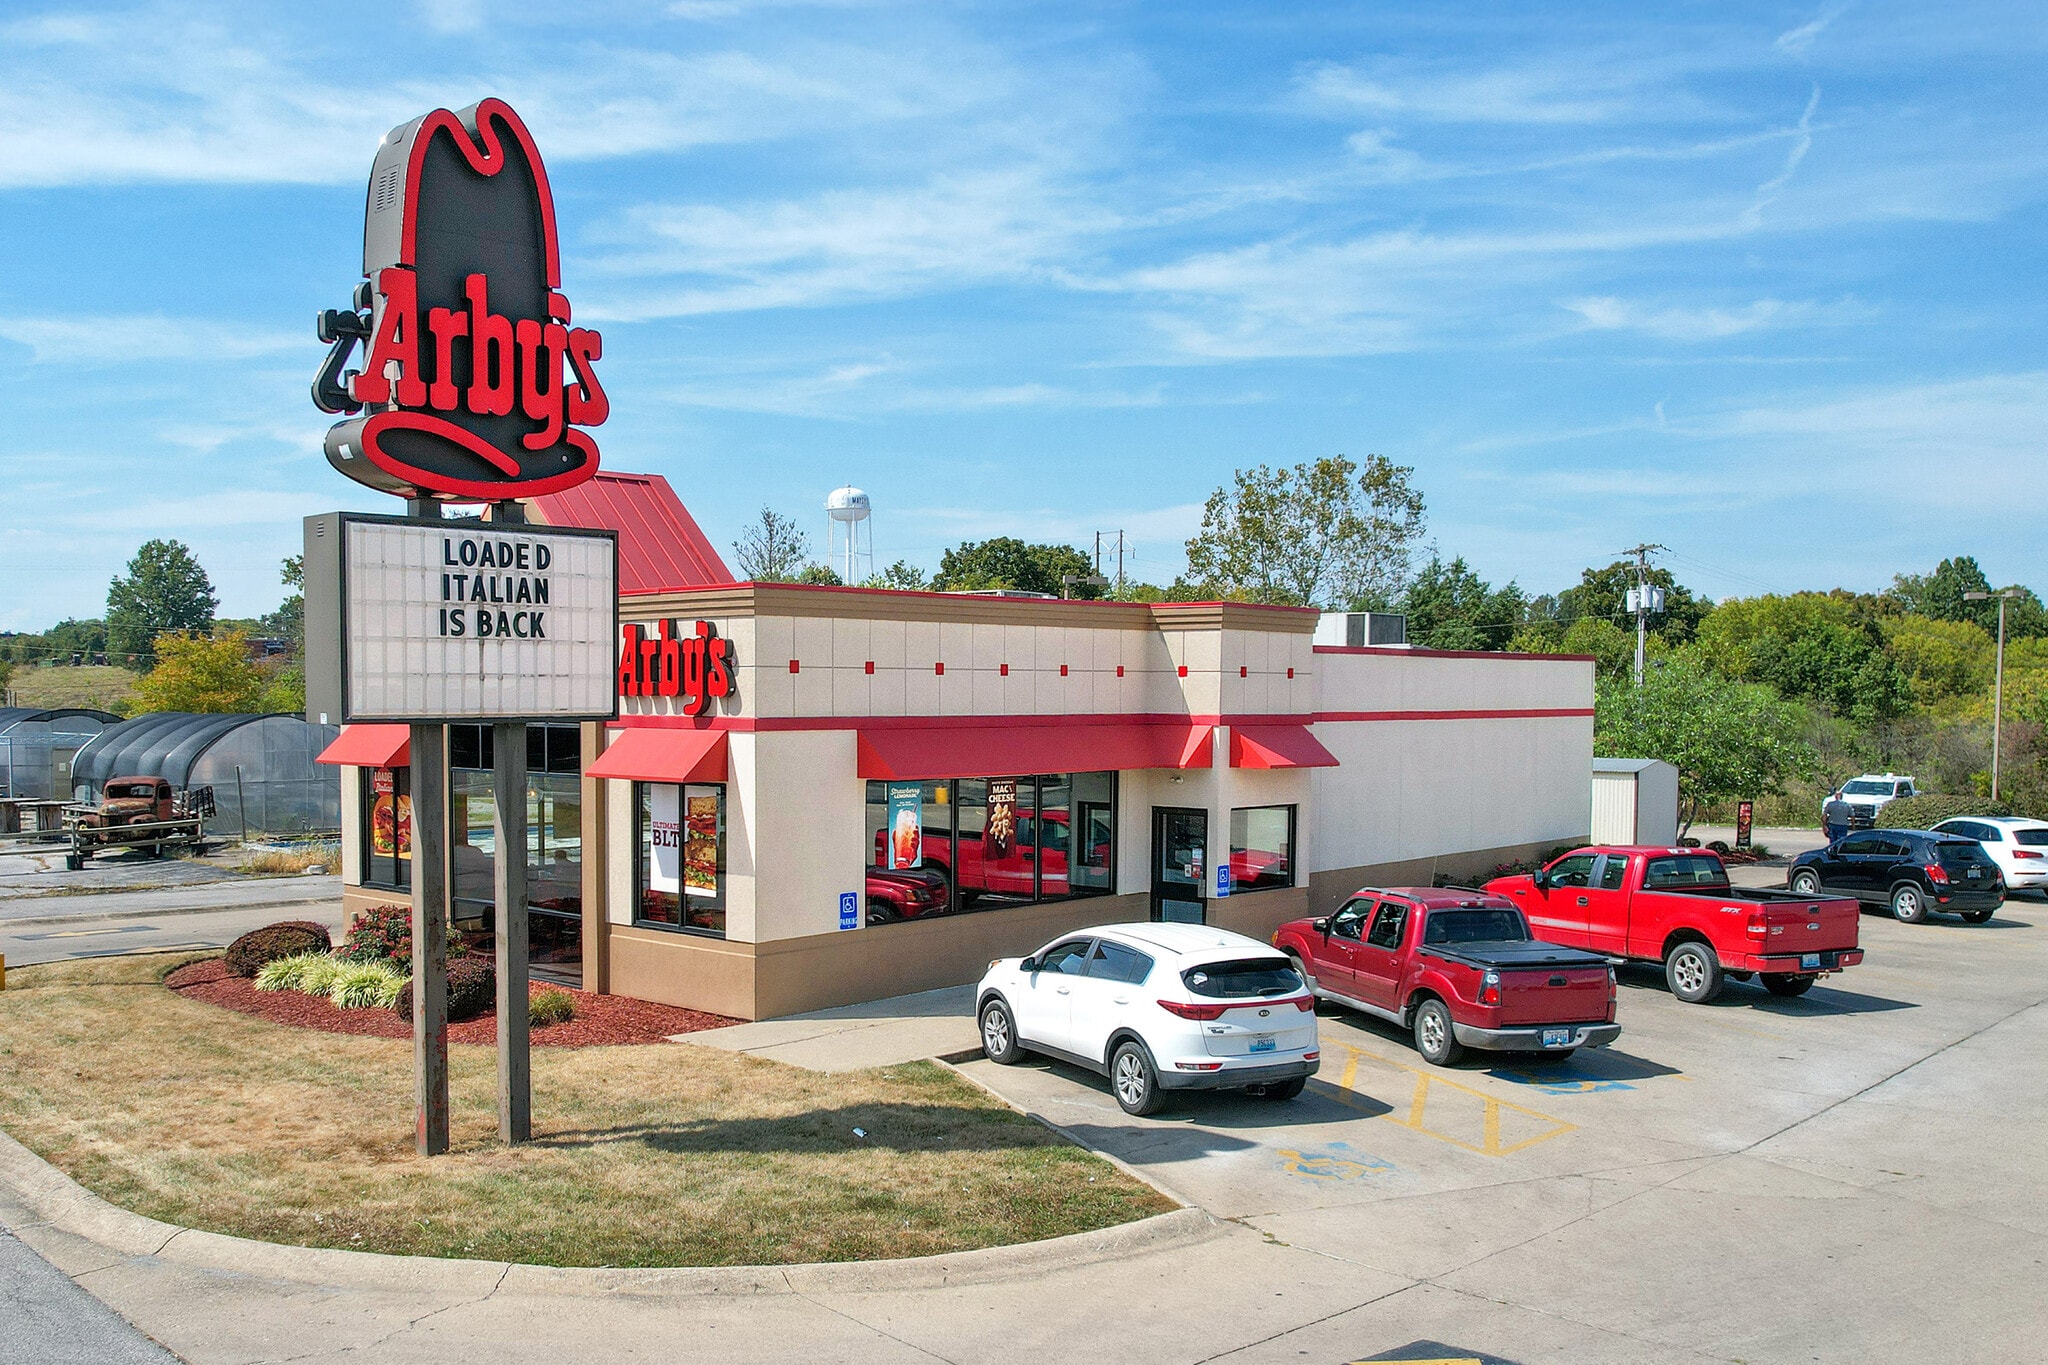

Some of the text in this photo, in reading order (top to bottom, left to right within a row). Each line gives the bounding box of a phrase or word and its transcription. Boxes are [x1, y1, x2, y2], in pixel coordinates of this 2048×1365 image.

[354, 268, 609, 450] Arby's
[444, 538, 551, 570] LOADED
[443, 574, 549, 604] ITALIAN
[439, 609, 545, 638] IS BACK
[619, 618, 736, 716] Arby's
[988, 793, 1016, 803] CHEESE
[652, 829, 680, 848] BLT
